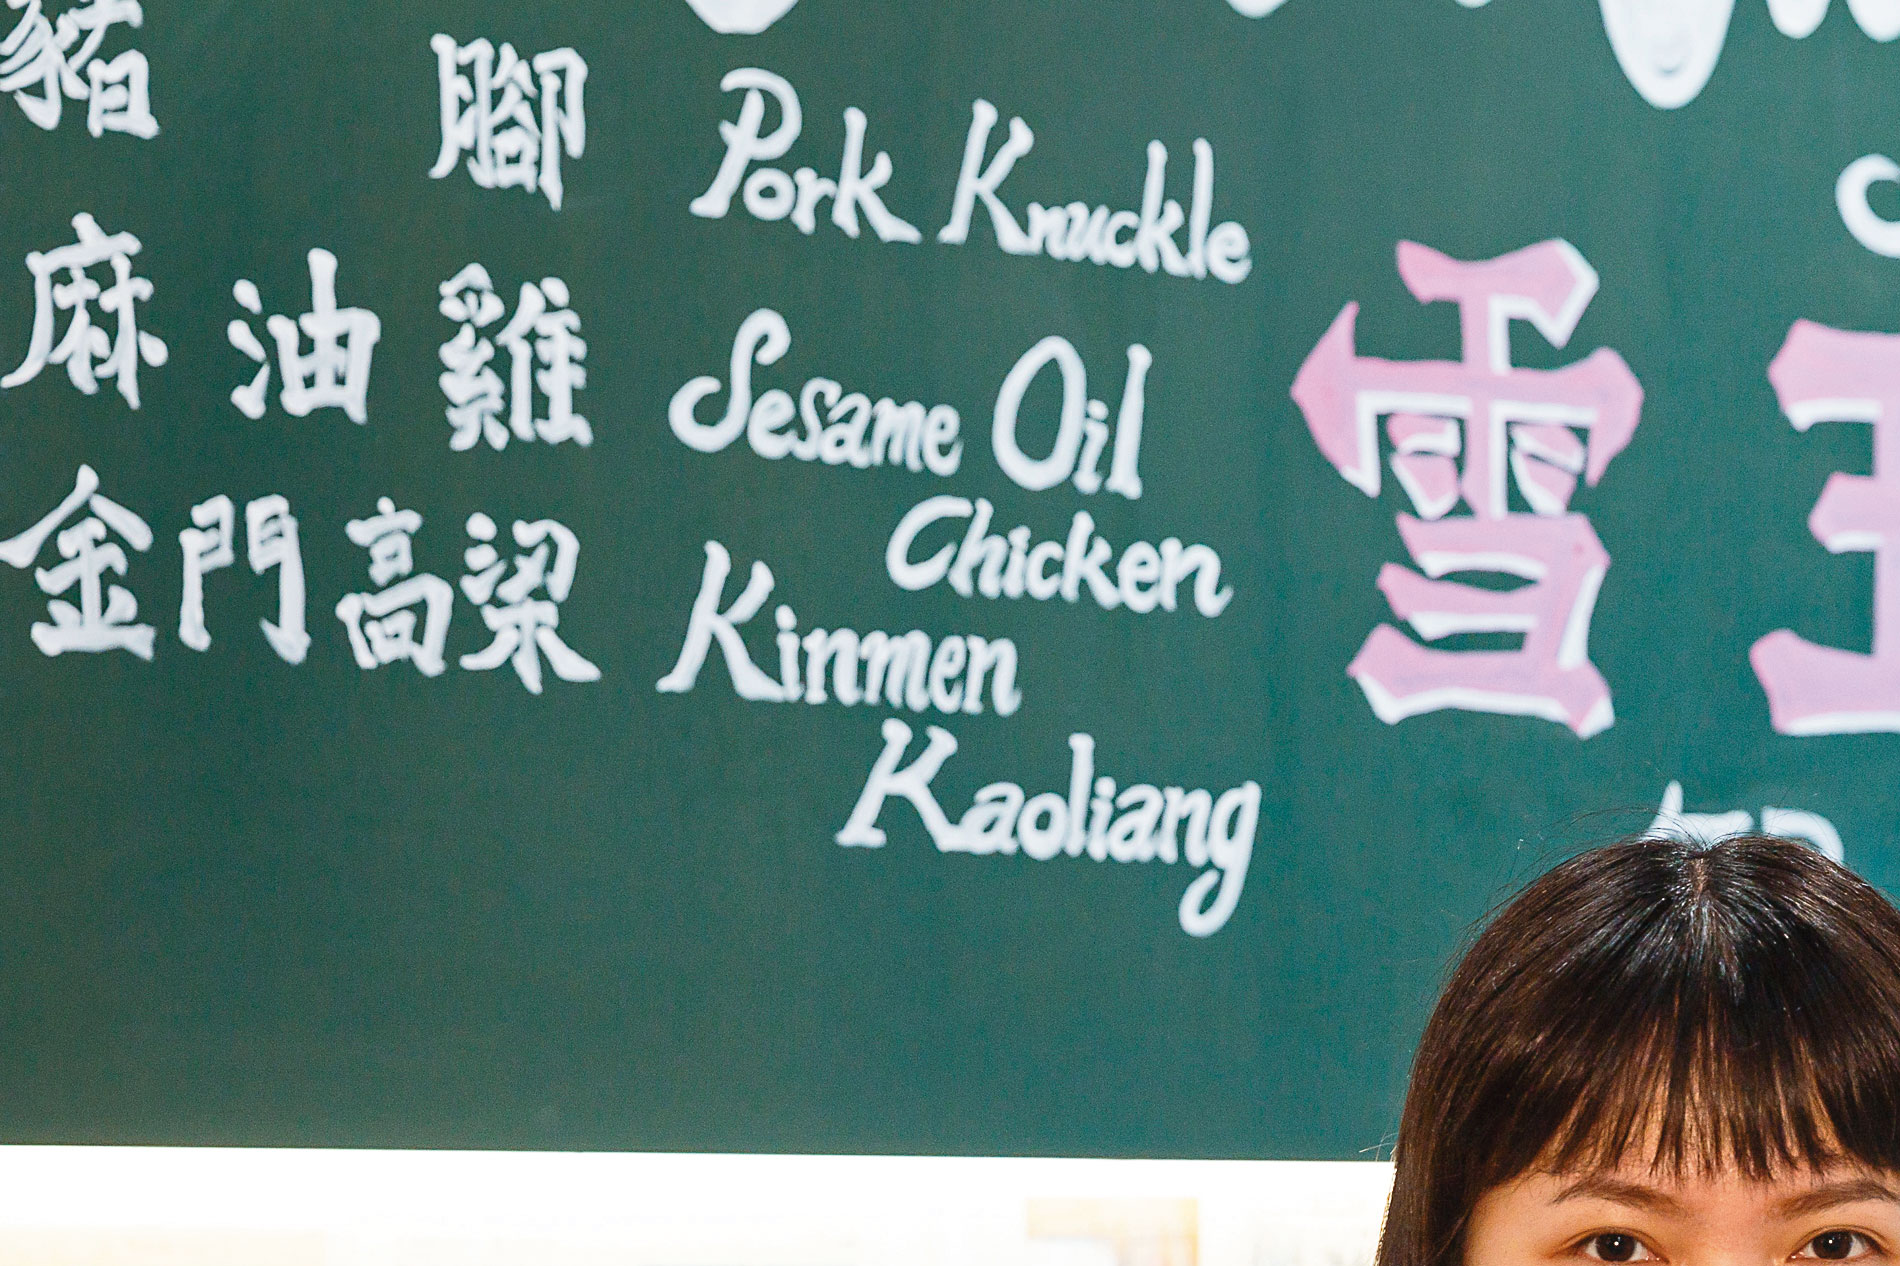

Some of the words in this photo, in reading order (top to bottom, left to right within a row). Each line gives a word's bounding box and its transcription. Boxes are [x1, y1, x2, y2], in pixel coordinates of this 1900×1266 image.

[690, 67, 922, 244] Pork
[938, 98, 1253, 285] Knuckle
[0, 212, 594, 452] 麻油雞
[668, 308, 963, 476] Sesame
[992, 335, 1153, 499] Oil
[656, 540, 1022, 716] Kinmen
[886, 495, 1234, 618] Chicken
[835, 717, 1261, 937] Kaoliang
